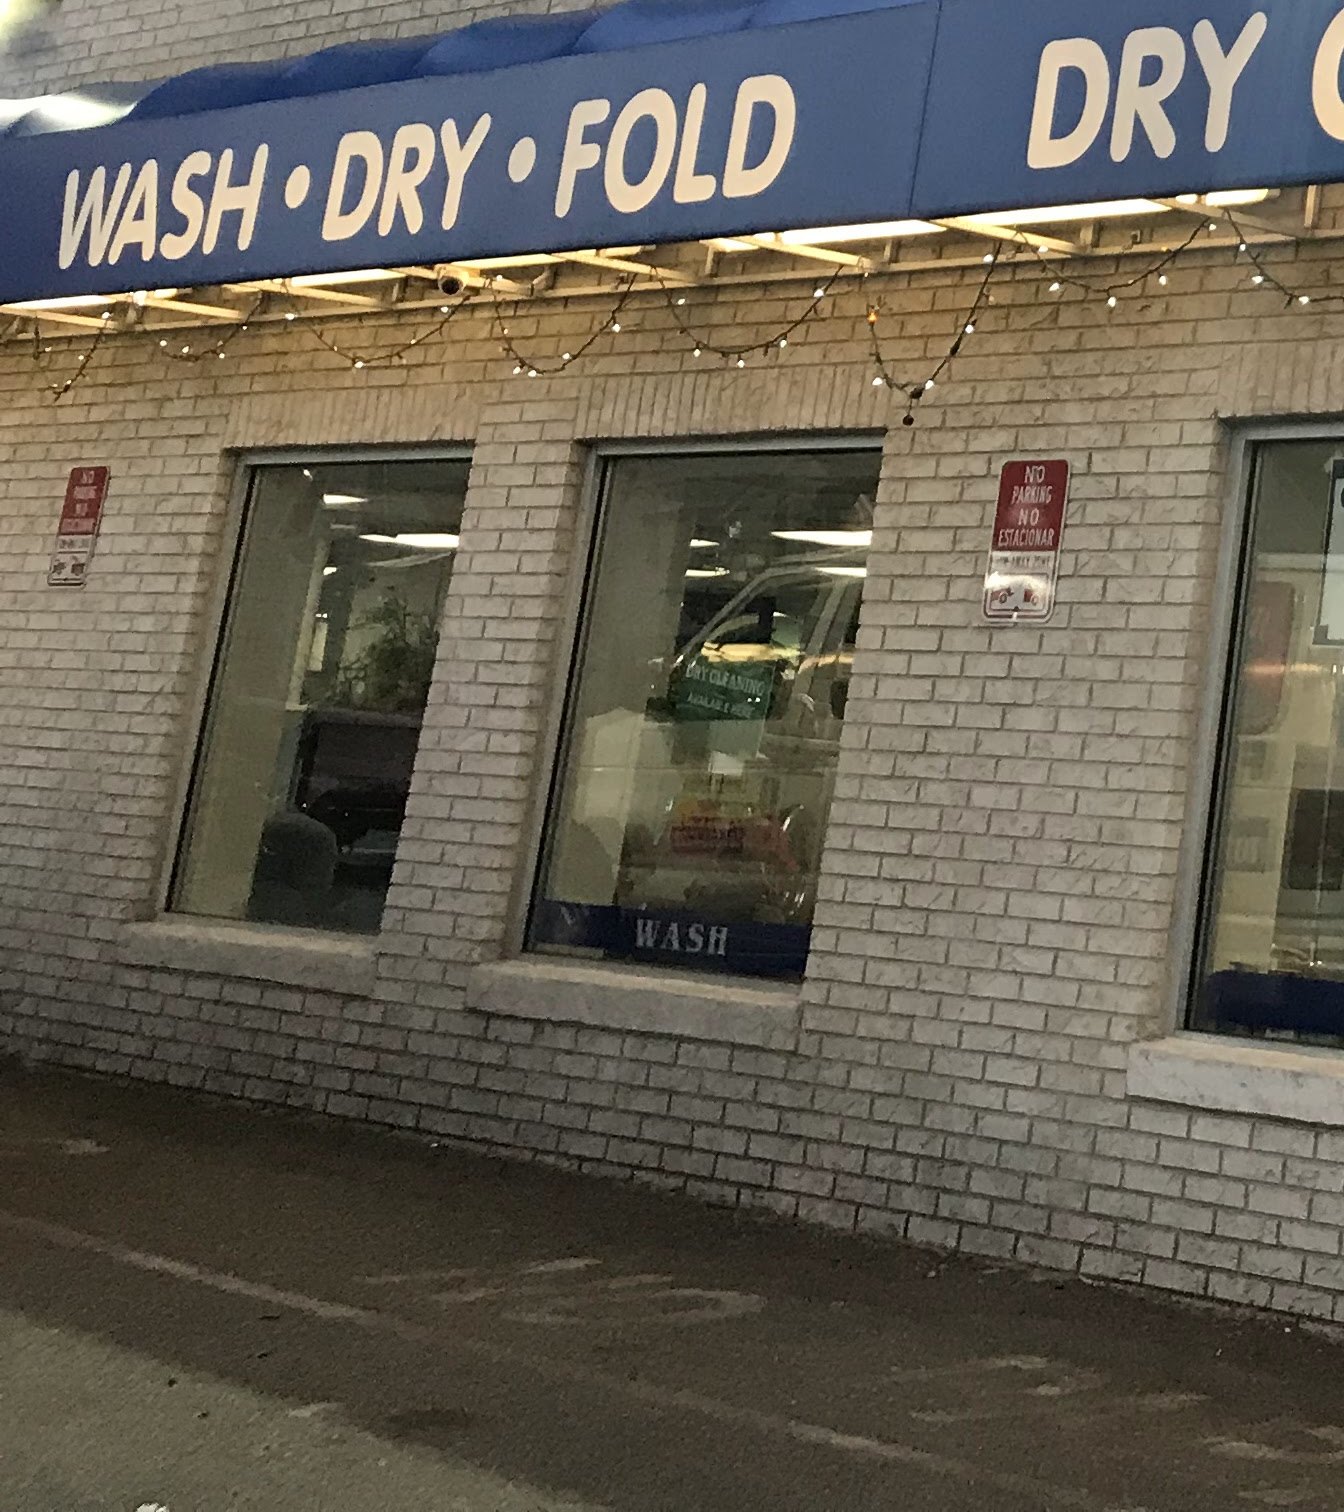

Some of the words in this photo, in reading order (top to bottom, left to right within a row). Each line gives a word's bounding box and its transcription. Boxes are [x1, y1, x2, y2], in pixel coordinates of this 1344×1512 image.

[1026, 10, 1267, 171] DRY
[58, 141, 270, 271] WASH
[322, 113, 491, 244] DRY
[554, 73, 796, 219] FOLD
[1024, 465, 1046, 484] NO
[1011, 485, 1053, 505] PARKING
[1018, 508, 1040, 527] NO
[998, 528, 1055, 547] ESTACIONAR
[636, 918, 729, 956] WASH
